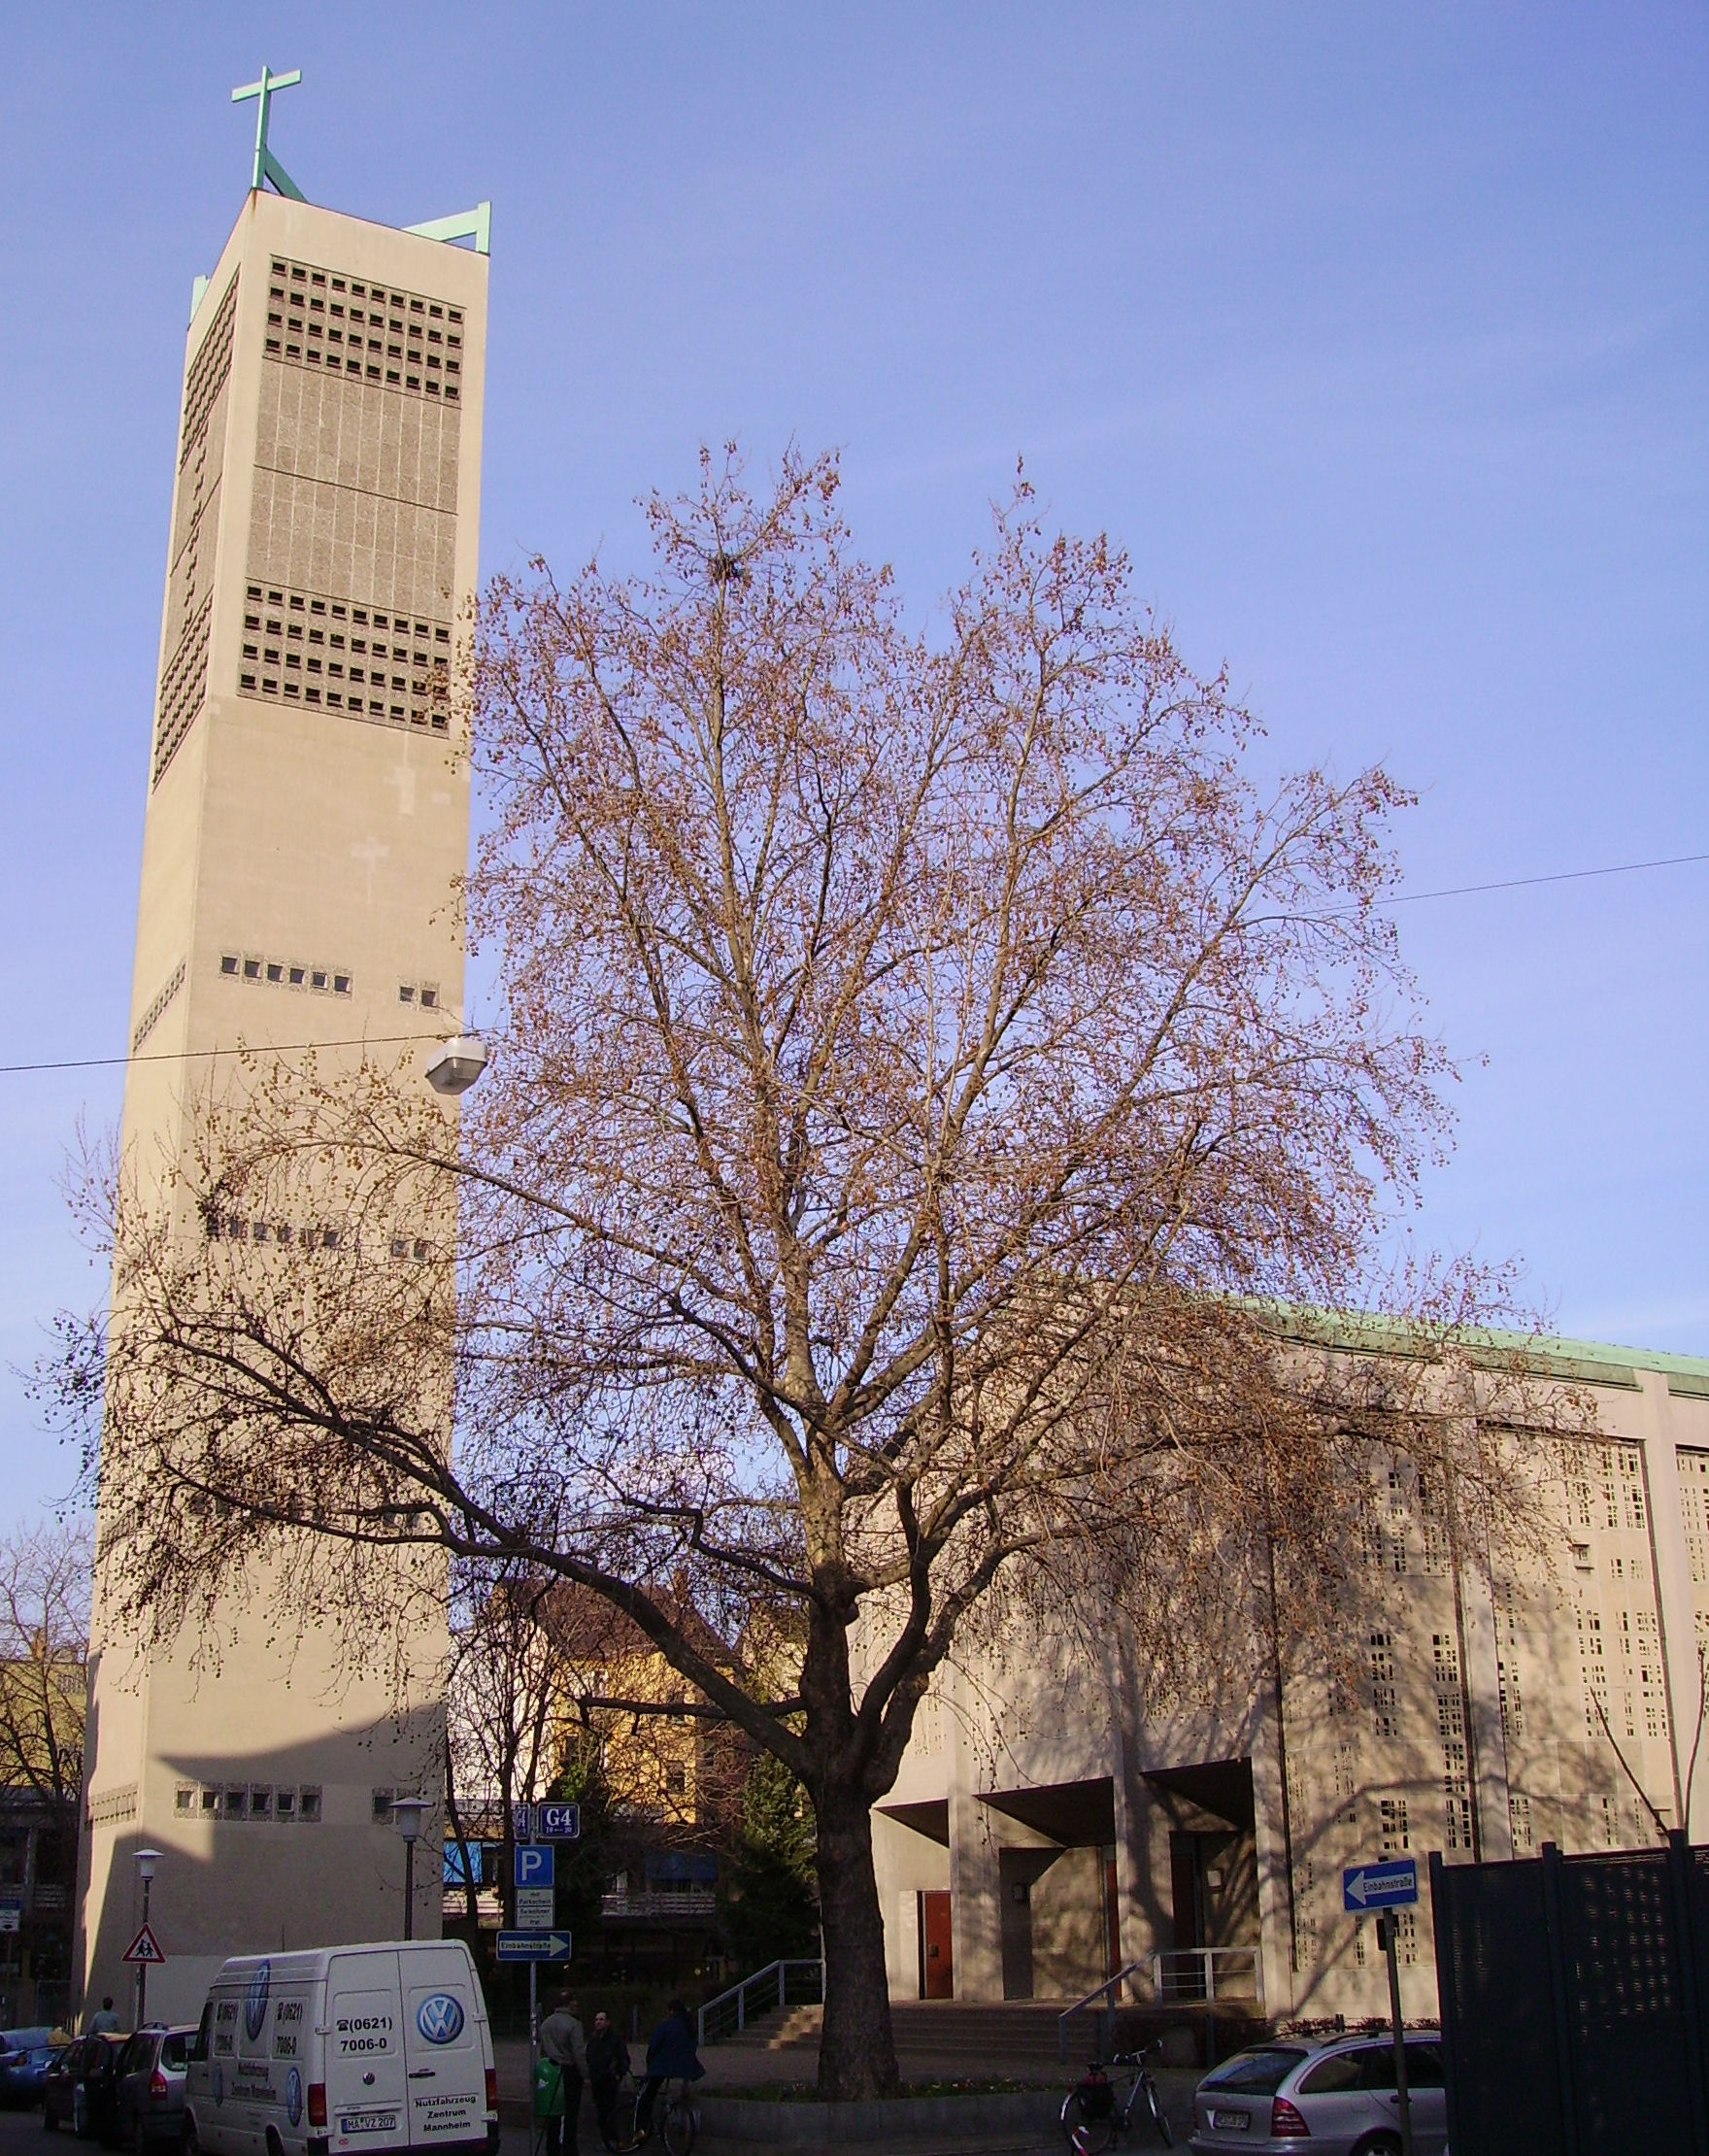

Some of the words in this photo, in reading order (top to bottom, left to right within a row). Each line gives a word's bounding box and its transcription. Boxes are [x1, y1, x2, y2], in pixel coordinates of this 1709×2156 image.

[546, 1808, 572, 1826] G4
[521, 1850, 542, 1881] P
[1363, 1876, 1412, 1892] Einbahnstraße
[350, 2017, 392, 2034] (0621)
[341, 2038, 387, 2052] 7006-0
[416, 2096, 477, 2108] Nutzfahrzeug
[427, 2109, 467, 2119] Zentrum
[348, 2119, 360, 2130] MA
[365, 2117, 377, 2128] VZ
[378, 2116, 394, 2127] 207
[423, 2121, 471, 2133] Mannheim
